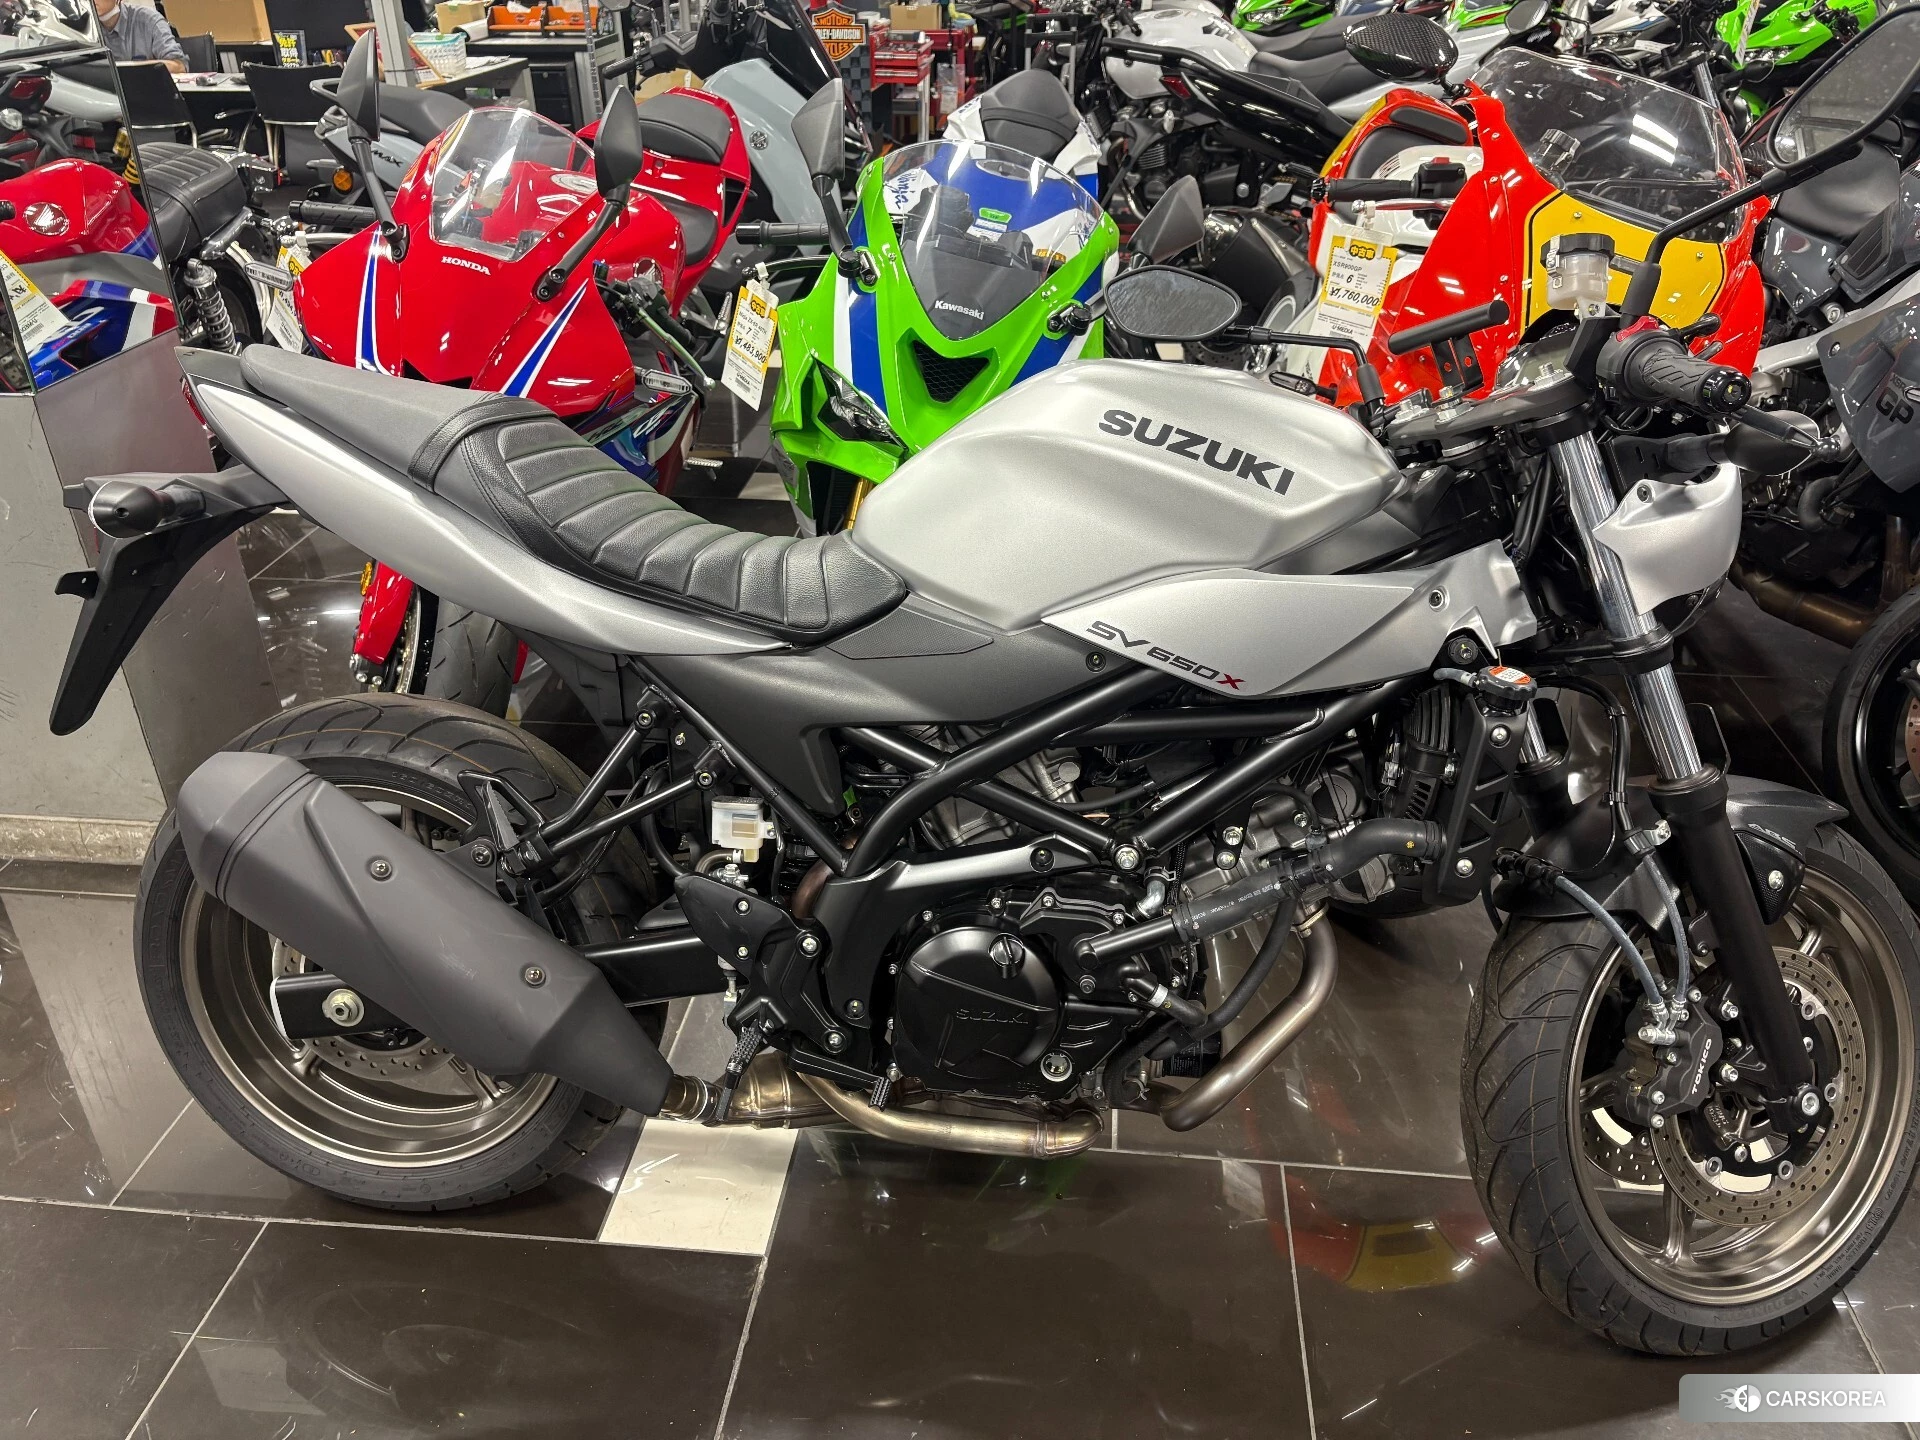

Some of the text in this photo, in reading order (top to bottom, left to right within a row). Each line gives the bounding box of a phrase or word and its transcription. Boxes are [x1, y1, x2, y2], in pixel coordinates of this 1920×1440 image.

[825, 42, 849, 56] YCLES
[1349, 244, 1375, 260] 中古車
[441, 256, 491, 275] HONDA
[1333, 260, 1363, 272] XSR900GP
[1346, 274, 1354, 284] 6
[934, 300, 985, 321] Kawasaki
[746, 327, 752, 335] 7
[1876, 386, 1914, 425] GP
[1098, 409, 1295, 496] SUZUKI
[1691, 1038, 1712, 1095] TOKICO
